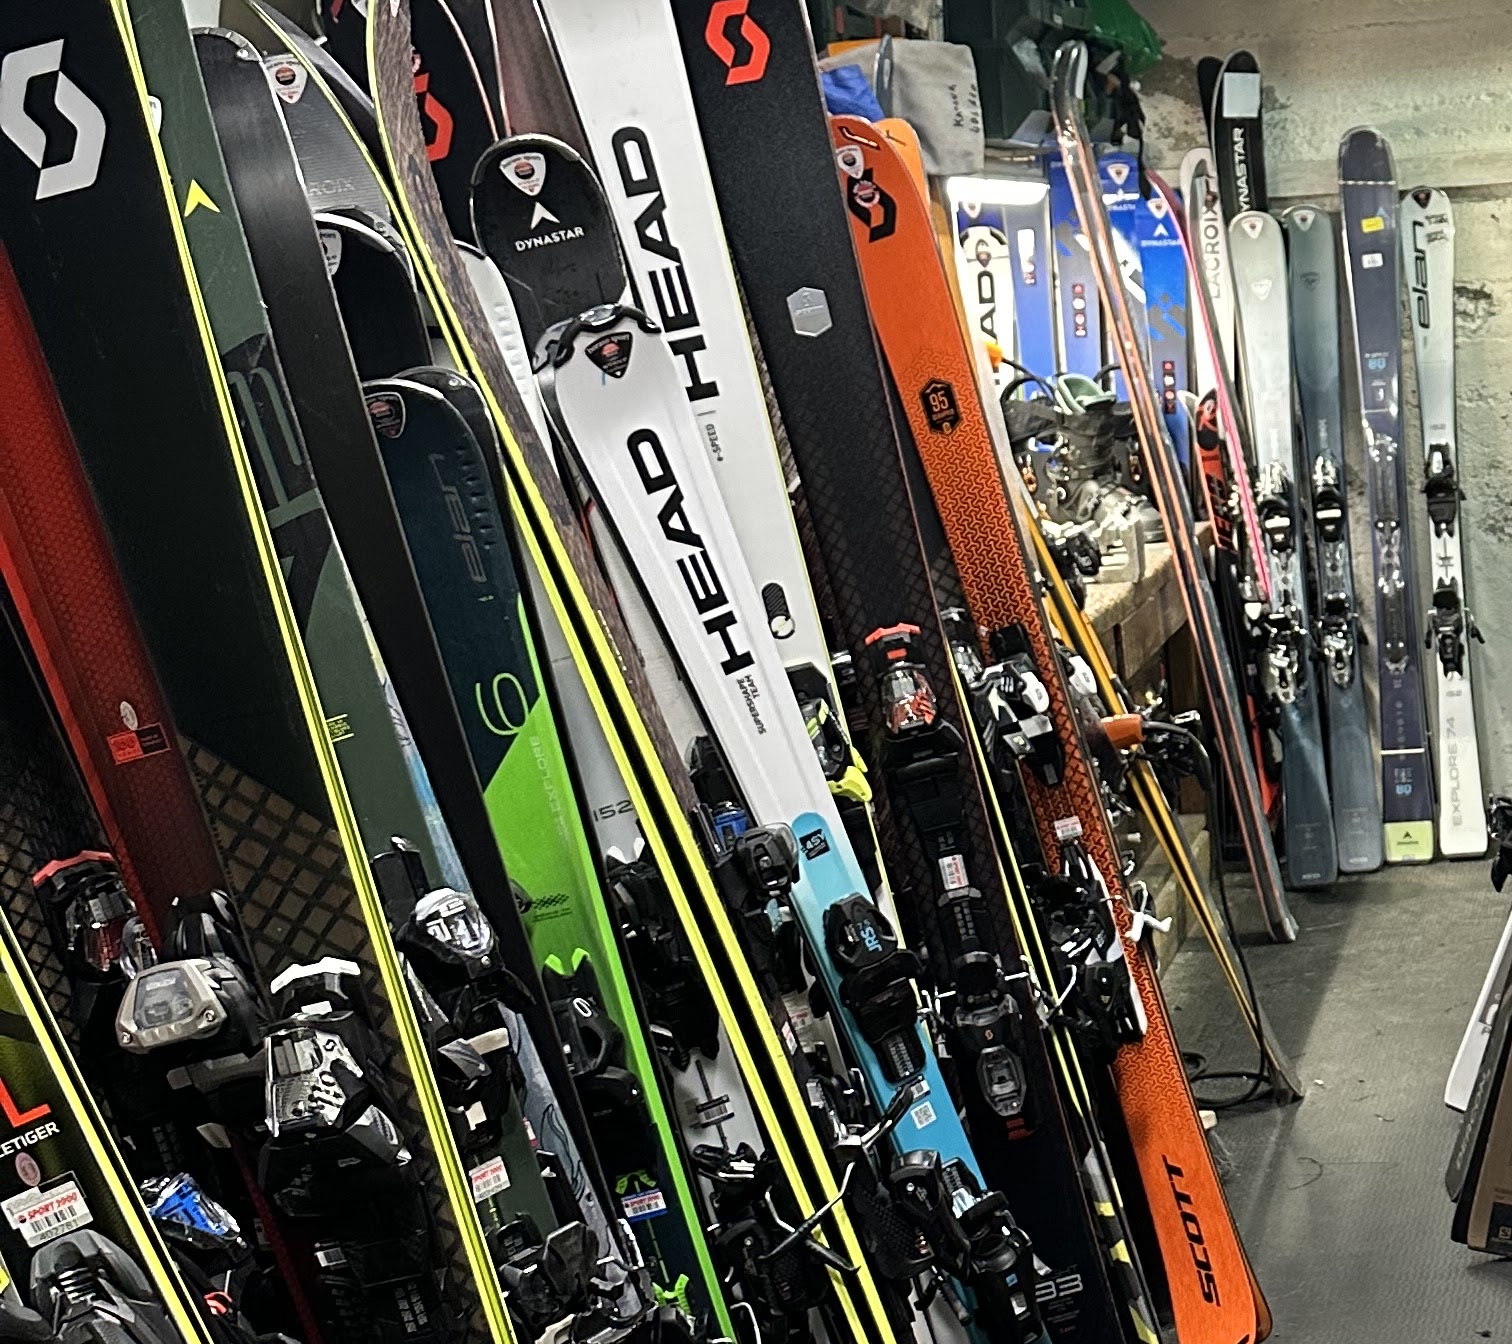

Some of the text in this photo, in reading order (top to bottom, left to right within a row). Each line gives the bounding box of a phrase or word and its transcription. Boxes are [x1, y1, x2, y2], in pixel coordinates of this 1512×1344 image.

[1238, 126, 1257, 214] YNASTAR
[514, 225, 586, 253] DYNASTAR
[611, 126, 720, 403] HEAD
[1404, 220, 1432, 332] elan
[929, 390, 950, 414] 95
[625, 428, 754, 676] HEAD
[591, 799, 634, 823] 152
[27, 1199, 55, 1222] SPORT
[1162, 1155, 1226, 1308] SCOTT
